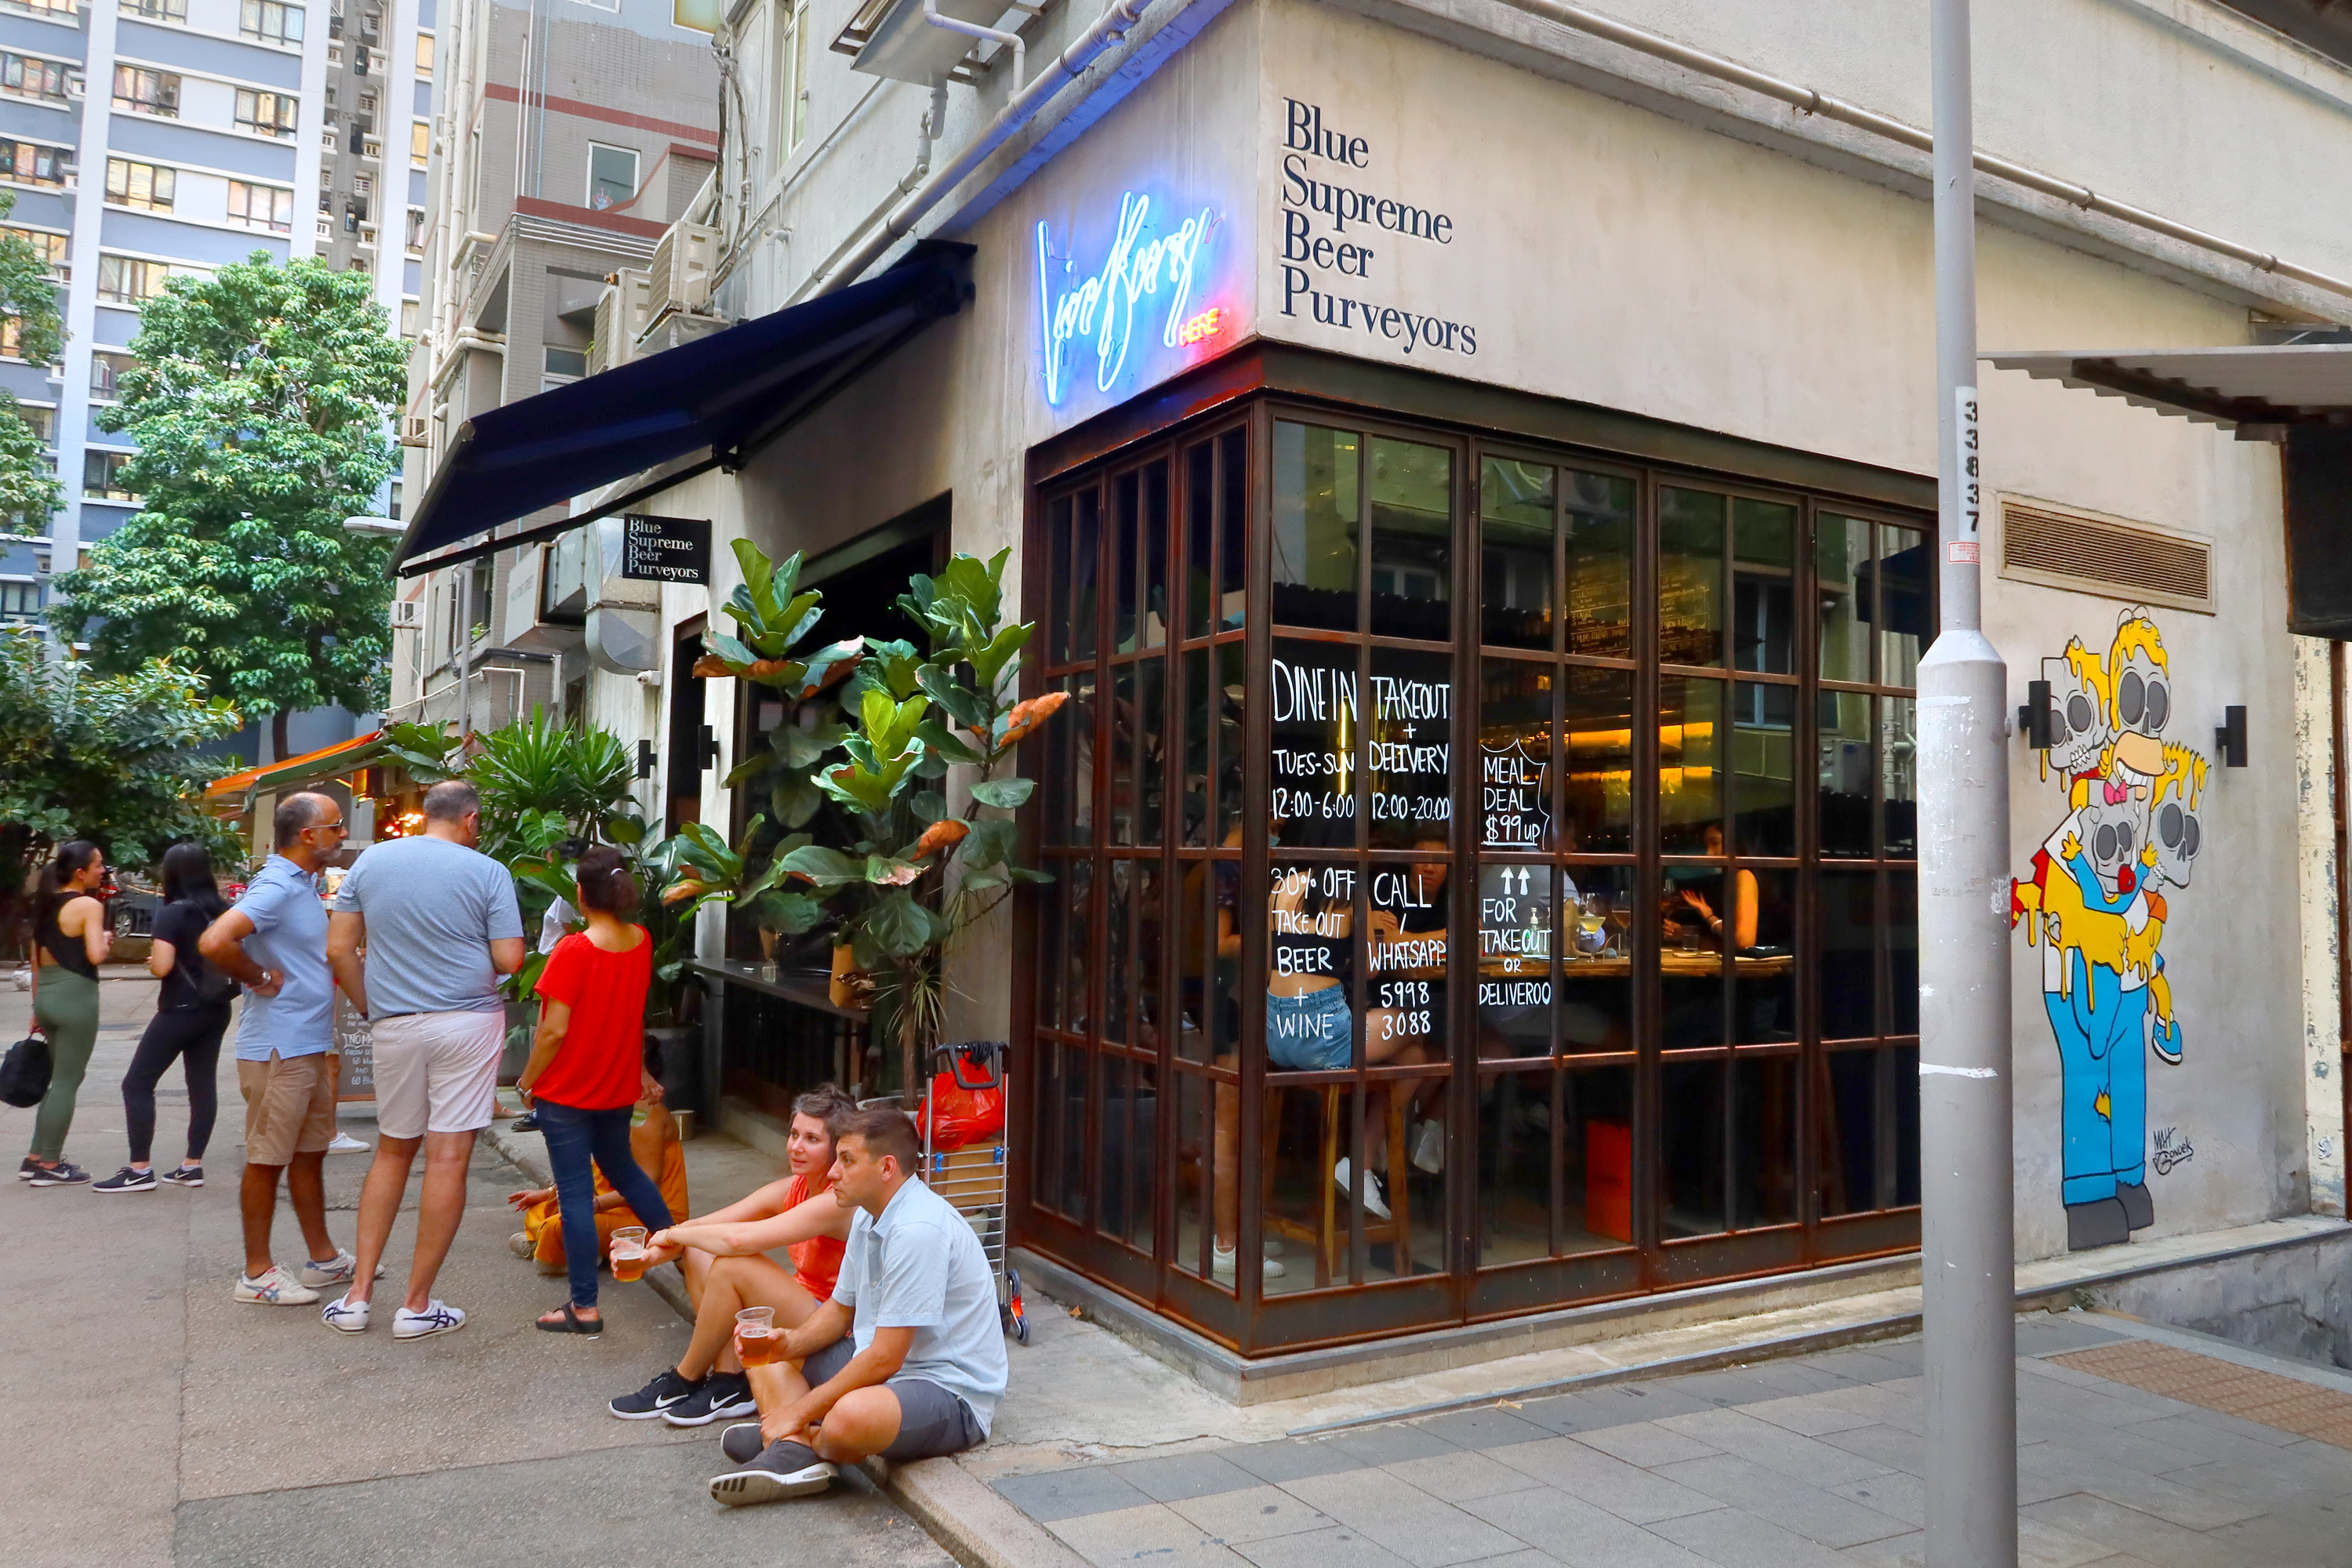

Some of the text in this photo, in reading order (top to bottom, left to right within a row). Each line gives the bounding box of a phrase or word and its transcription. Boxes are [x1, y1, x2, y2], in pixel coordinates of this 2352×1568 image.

[1282, 96, 1369, 169] Blue
[1283, 154, 1453, 244] Supreme
[1281, 209, 1374, 278] Beer
[1280, 264, 1476, 355] Purveyors
[1179, 307, 1219, 347] HERE
[629, 518, 662, 534] Blue
[628, 545, 662, 561] Beer
[629, 531, 693, 551] Supreme
[628, 559, 699, 581] Purveyors
[1272, 659, 1357, 722] DINE IN
[1370, 677, 1450, 720] TAKEOUT
[1272, 750, 1356, 777] TUES-SUN
[1369, 740, 1449, 775] DELIVERY
[1484, 757, 1536, 785] MEAL
[1484, 787, 1533, 812] DEAL
[1485, 814, 1522, 844] $99
[1271, 866, 1356, 901] 30% OFF
[1374, 873, 1432, 908] CALL
[1483, 897, 1517, 923] FOR
[1316, 911, 1345, 938] OUT
[1479, 929, 1552, 953] TAKEOUT
[1276, 946, 1333, 977] BEER
[1367, 939, 1446, 972] WHATSAPP
[1504, 958, 1522, 973] OR
[1381, 982, 1430, 1008] 5998
[1479, 982, 1552, 1006] DELIVEROO
[349, 1034, 361, 1044] NO
[1276, 1014, 1334, 1040] WINE
[1381, 1011, 1431, 1040] 3088
